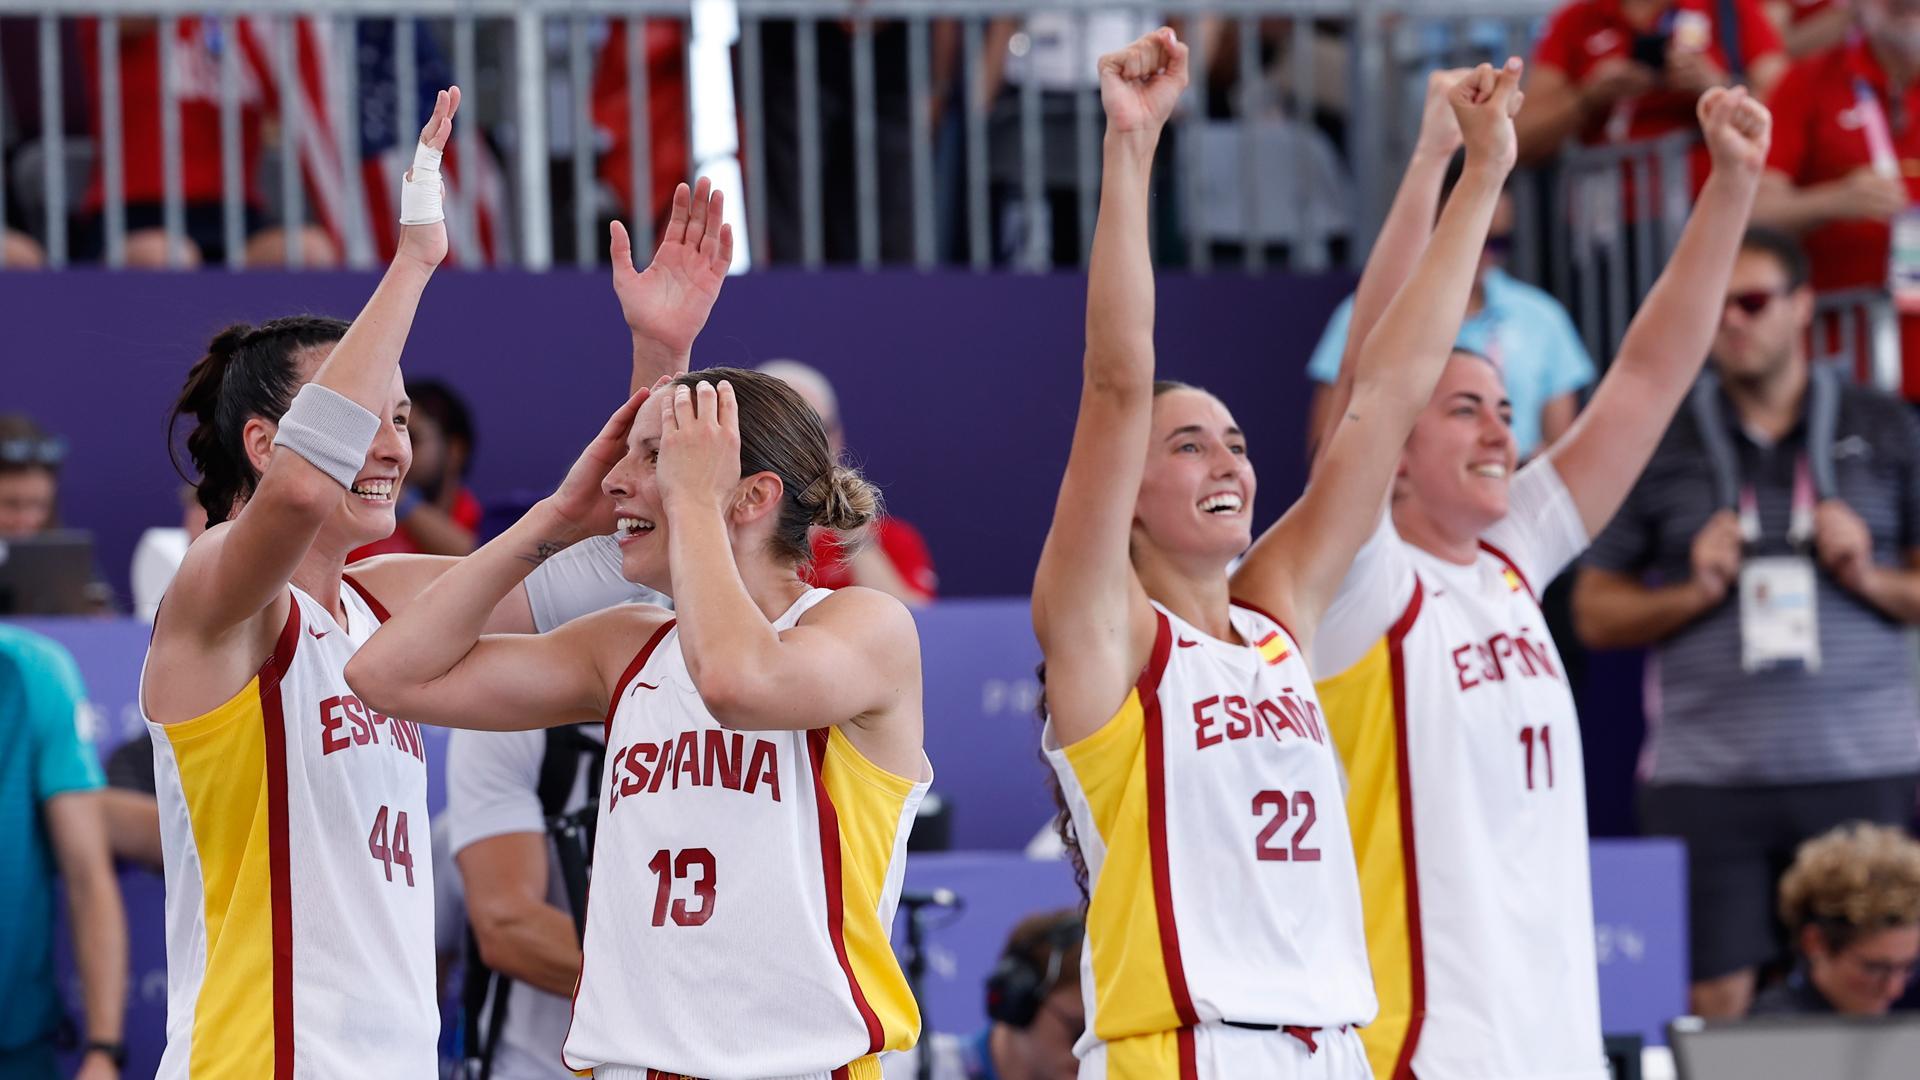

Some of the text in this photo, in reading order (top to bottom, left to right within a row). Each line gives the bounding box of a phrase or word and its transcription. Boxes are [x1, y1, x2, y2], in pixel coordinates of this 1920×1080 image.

[1519, 725, 1554, 790] 11
[368, 805, 415, 887] 44
[1251, 790, 1321, 861] 22
[648, 848, 717, 926] 13
